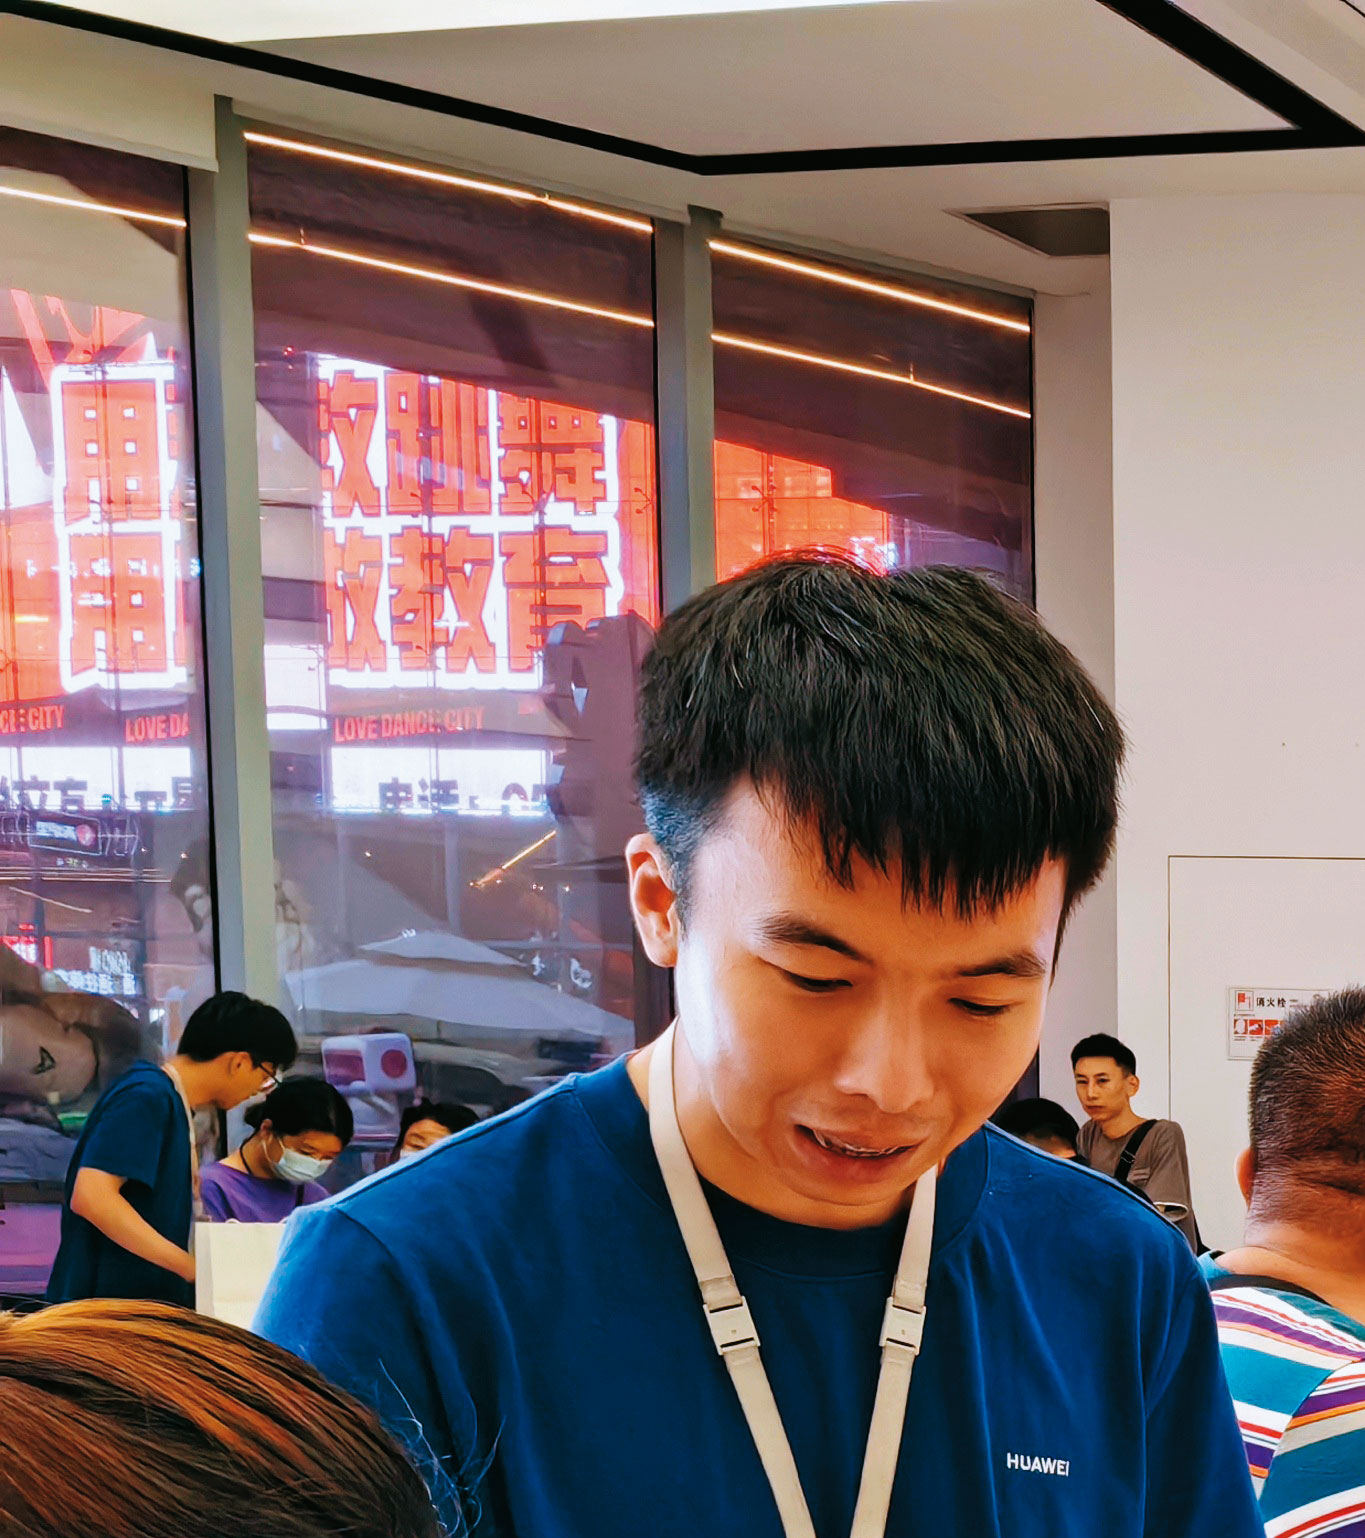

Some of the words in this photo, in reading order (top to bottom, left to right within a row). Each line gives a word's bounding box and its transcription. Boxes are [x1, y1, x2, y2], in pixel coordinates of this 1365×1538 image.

[125, 714, 166, 743] LOVE
[334, 716, 378, 743] LOVE
[444, 706, 485, 732] CITY
[1006, 1451, 1070, 1477] HUAWEI
